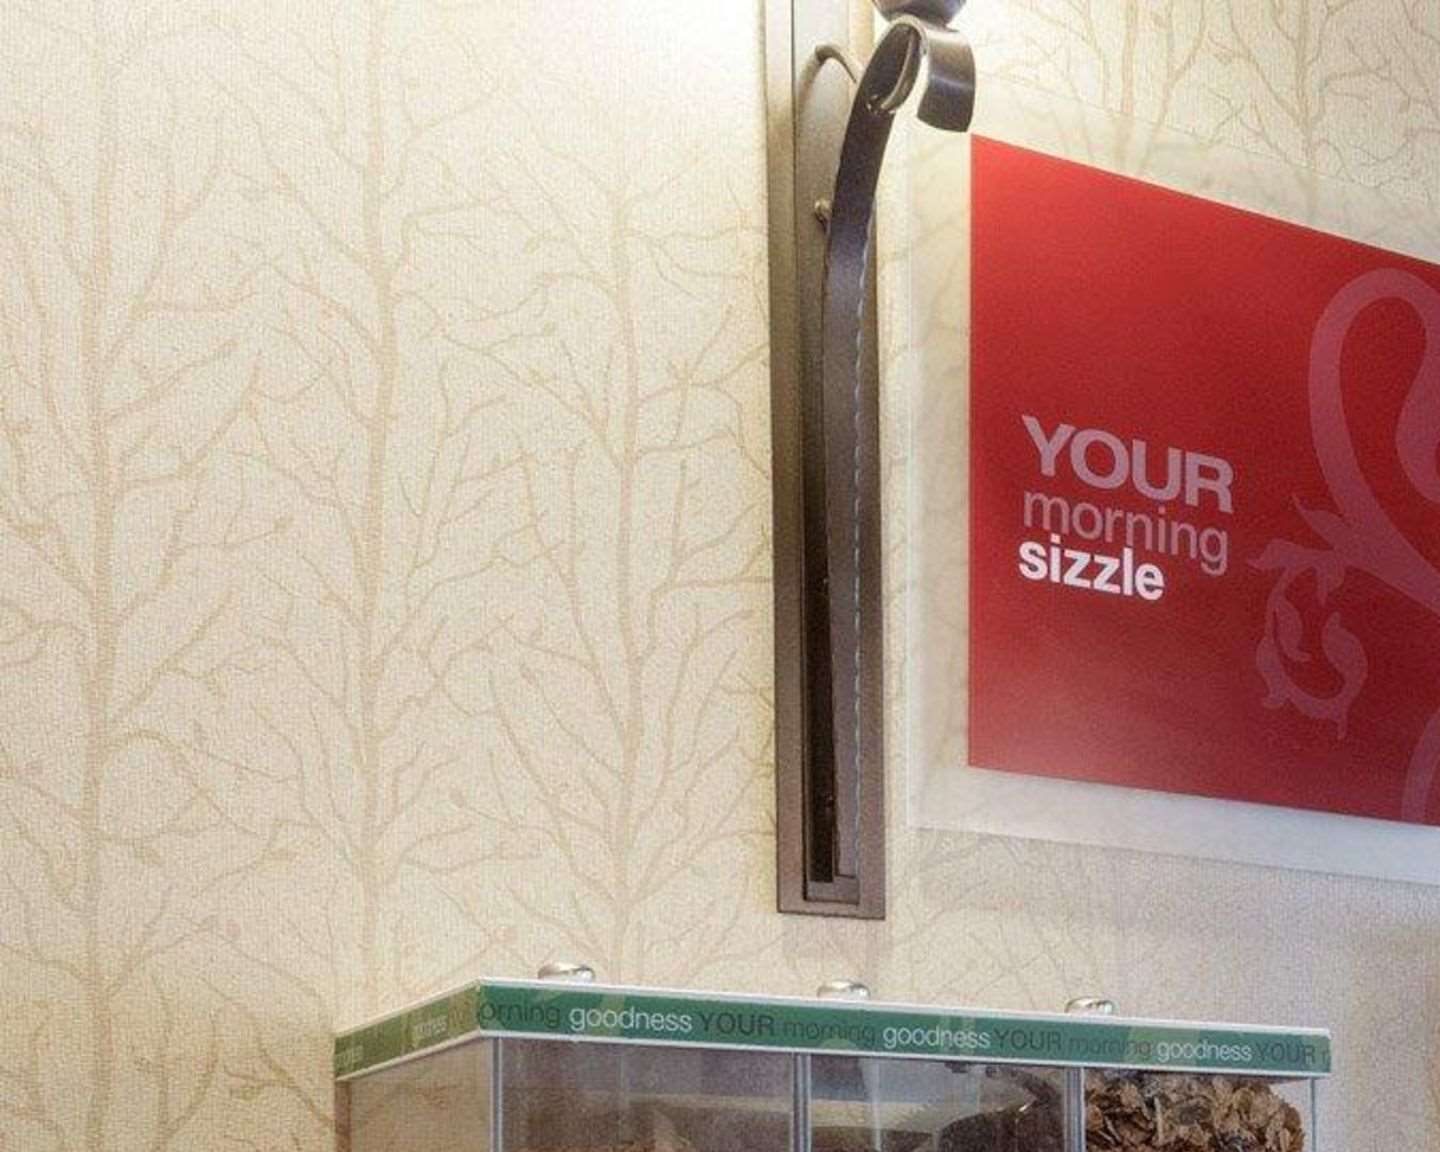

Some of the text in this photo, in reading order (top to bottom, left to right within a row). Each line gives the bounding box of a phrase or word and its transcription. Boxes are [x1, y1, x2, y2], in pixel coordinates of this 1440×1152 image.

[1021, 413, 1235, 513] YOUR
[1018, 533, 1165, 601] sizzle
[1023, 490, 1229, 576] morning
[477, 1001, 561, 1028] orning
[568, 1005, 693, 1032] goodness
[699, 1011, 775, 1037] YOUR
[783, 1019, 876, 1046] morning
[882, 1025, 991, 1050] goodness
[993, 1028, 1062, 1051] YOUR
[1069, 1035, 1152, 1060] morning
[1157, 1039, 1252, 1062] goodness
[1255, 1041, 1316, 1064] YOUR
